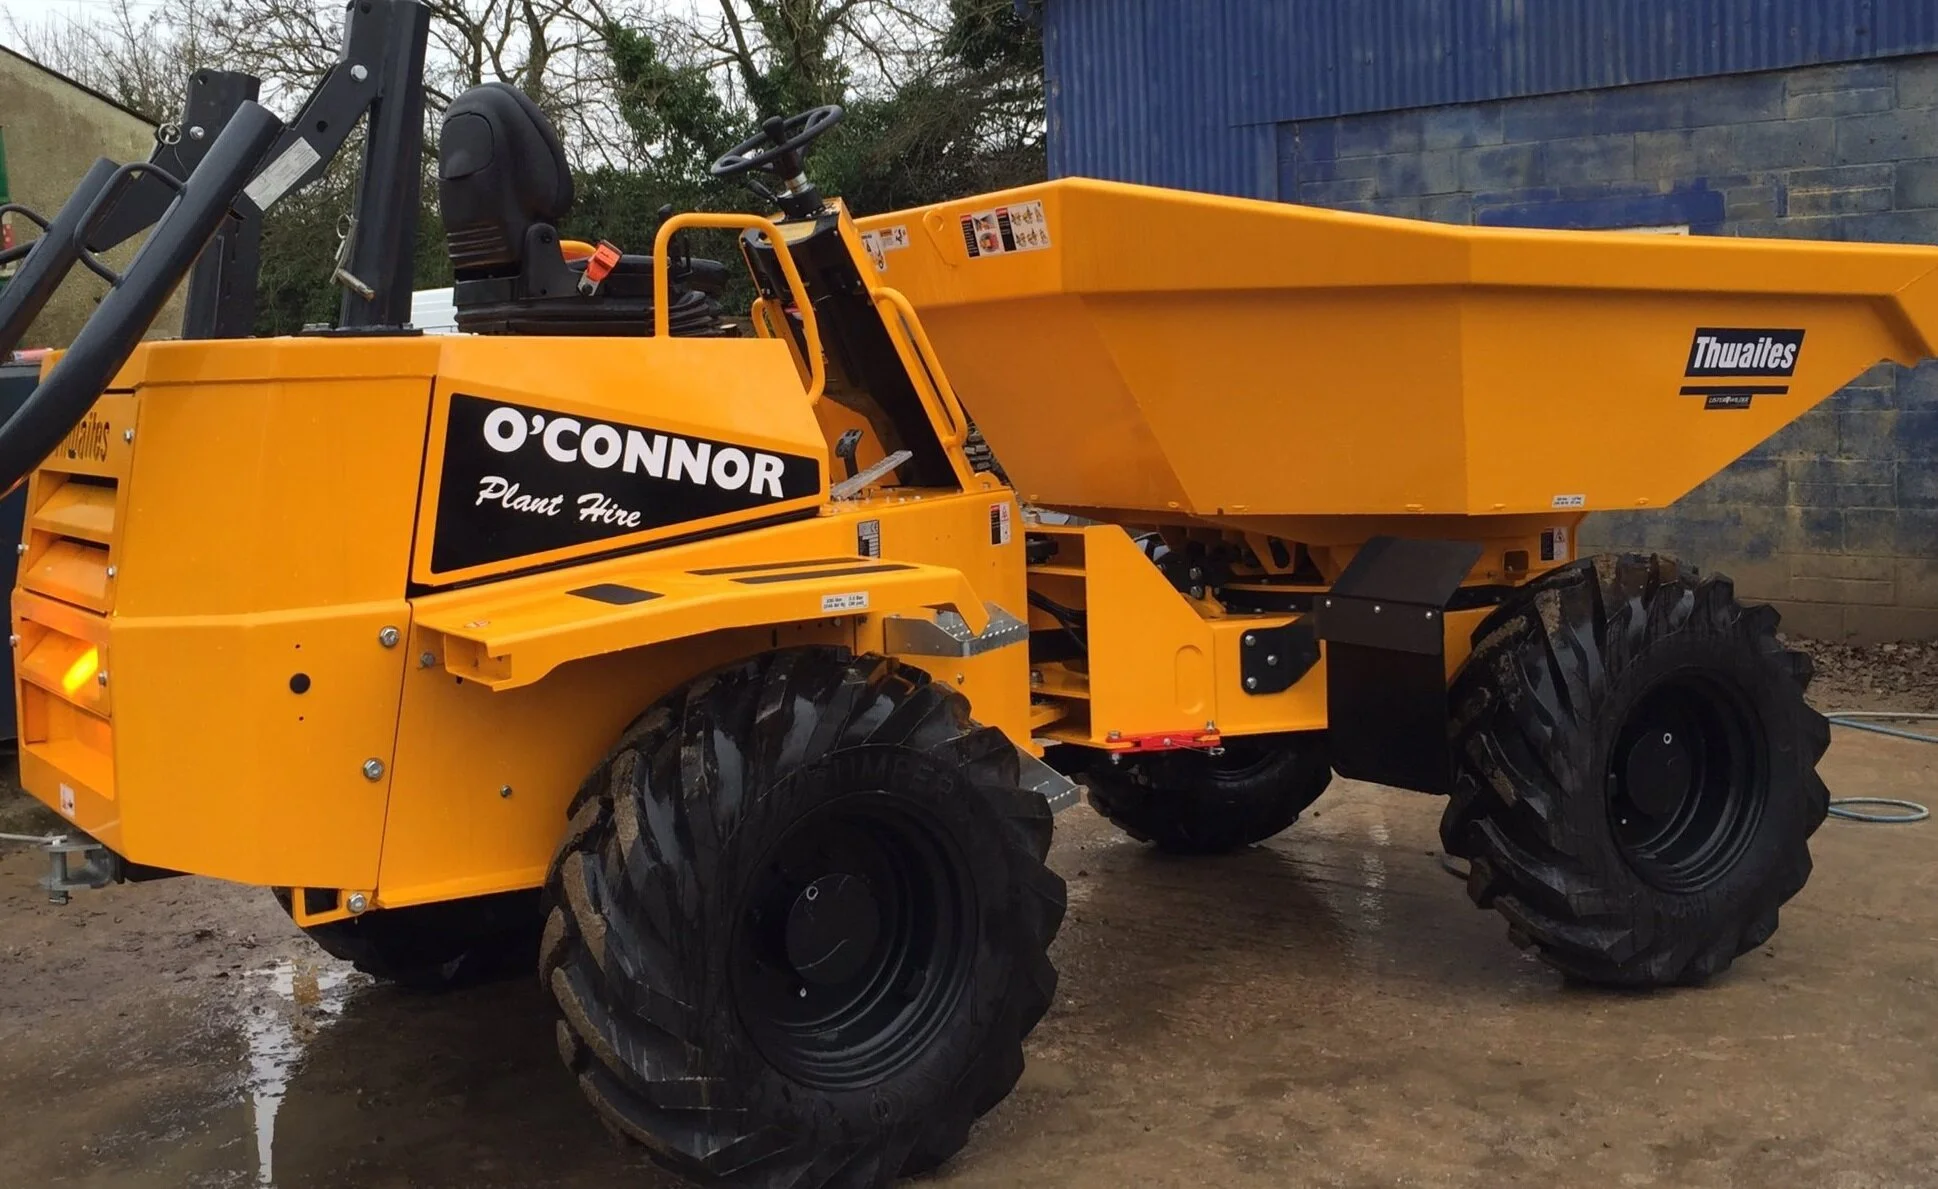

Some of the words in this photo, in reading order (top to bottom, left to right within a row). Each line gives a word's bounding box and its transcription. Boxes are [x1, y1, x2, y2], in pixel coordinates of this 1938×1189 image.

[1693, 336, 1797, 369] Thwaites
[483, 406, 785, 498] O’CONNOR
[475, 476, 565, 517] Plant
[576, 492, 641, 528] Hire
